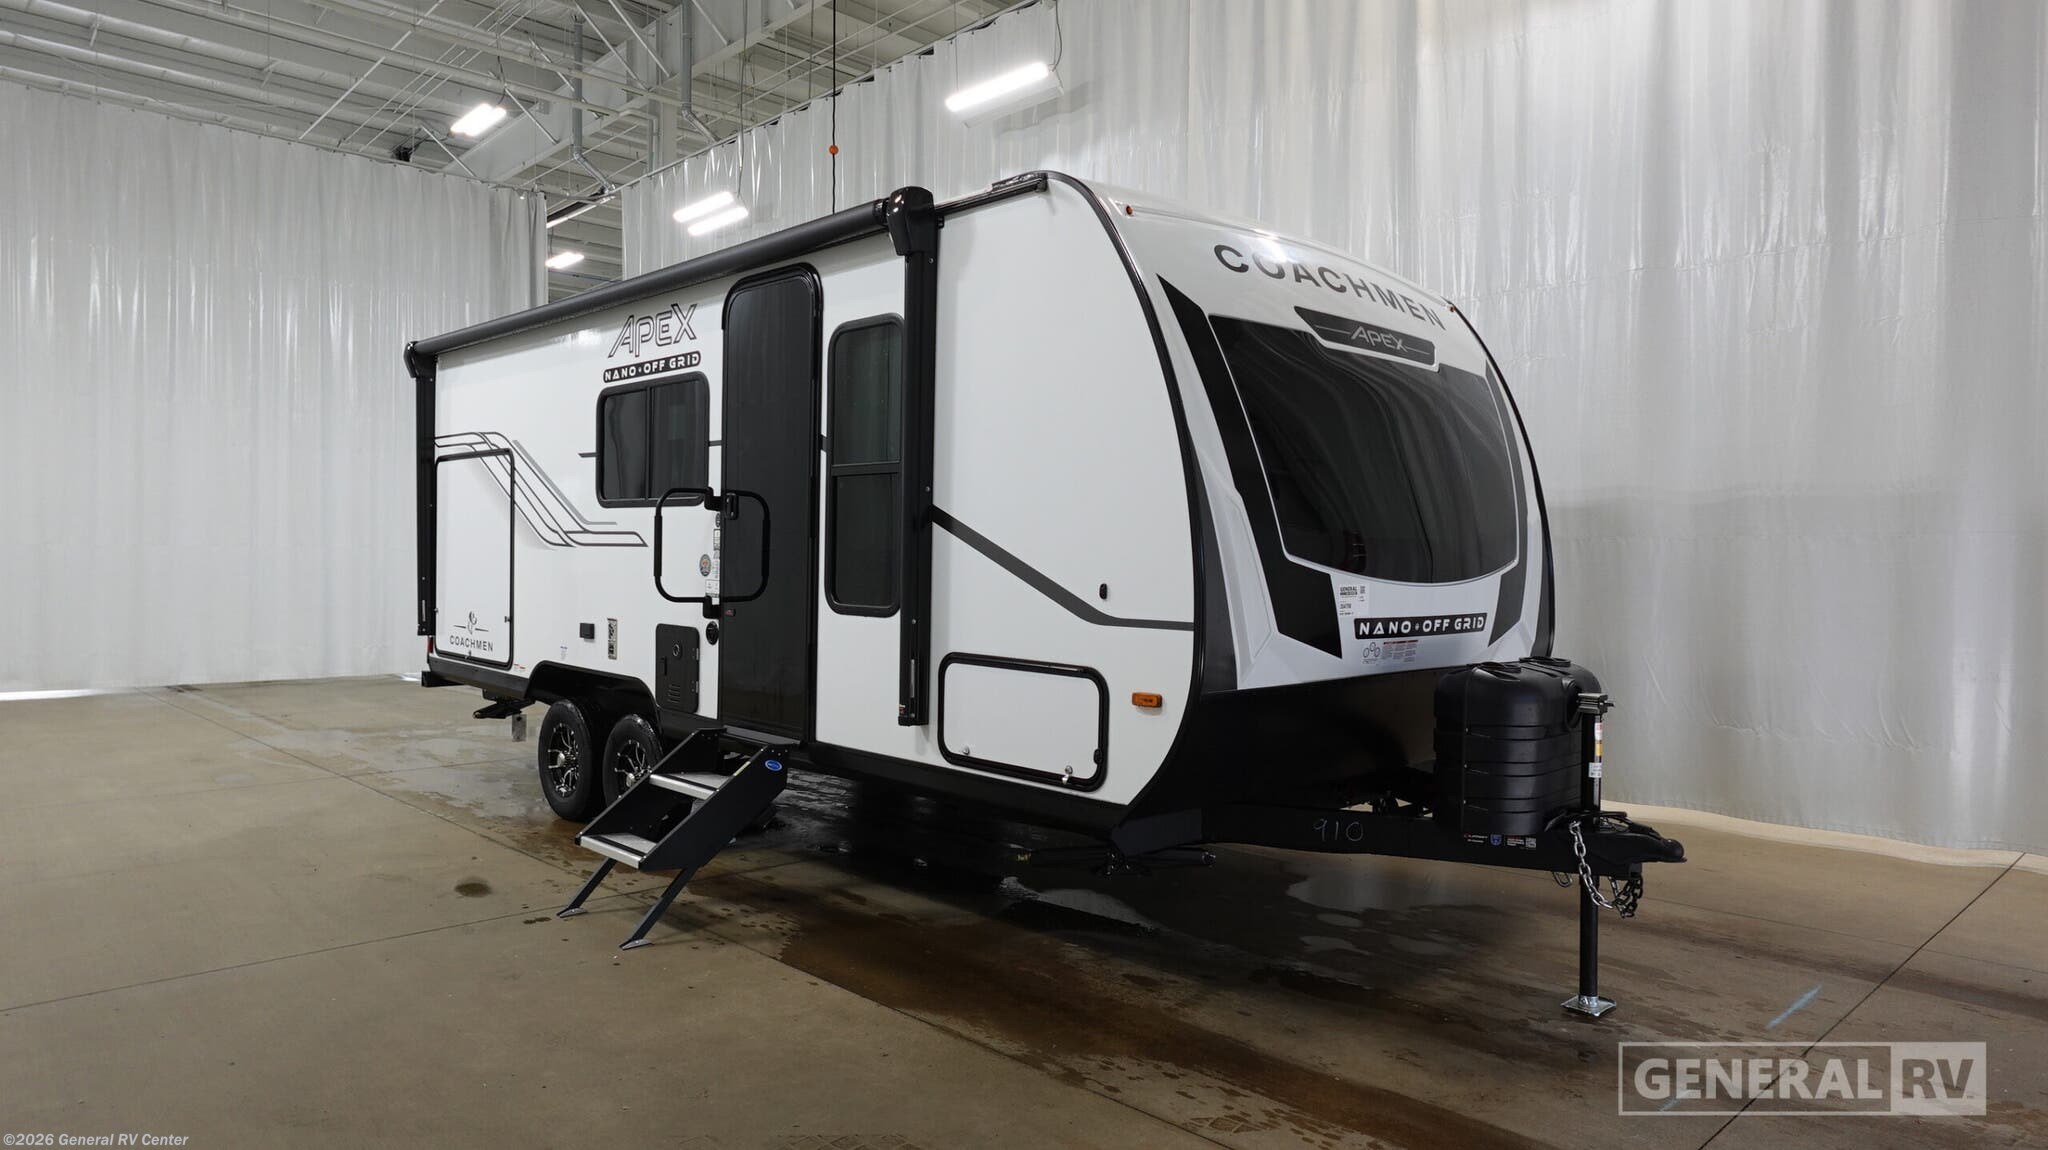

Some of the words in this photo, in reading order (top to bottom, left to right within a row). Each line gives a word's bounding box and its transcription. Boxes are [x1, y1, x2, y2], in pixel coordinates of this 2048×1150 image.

[1213, 244, 1447, 331] COACHMEN
[607, 303, 698, 358] APEX
[1350, 325, 1408, 352] APEX
[604, 365, 637, 382] NANO
[643, 360, 666, 374] OFF
[669, 353, 701, 368] GRID
[1358, 620, 1411, 636] NANO
[1422, 618, 1451, 632] OFF
[1454, 616, 1485, 631] GRID
[449, 634, 494, 653] COACHMEN
